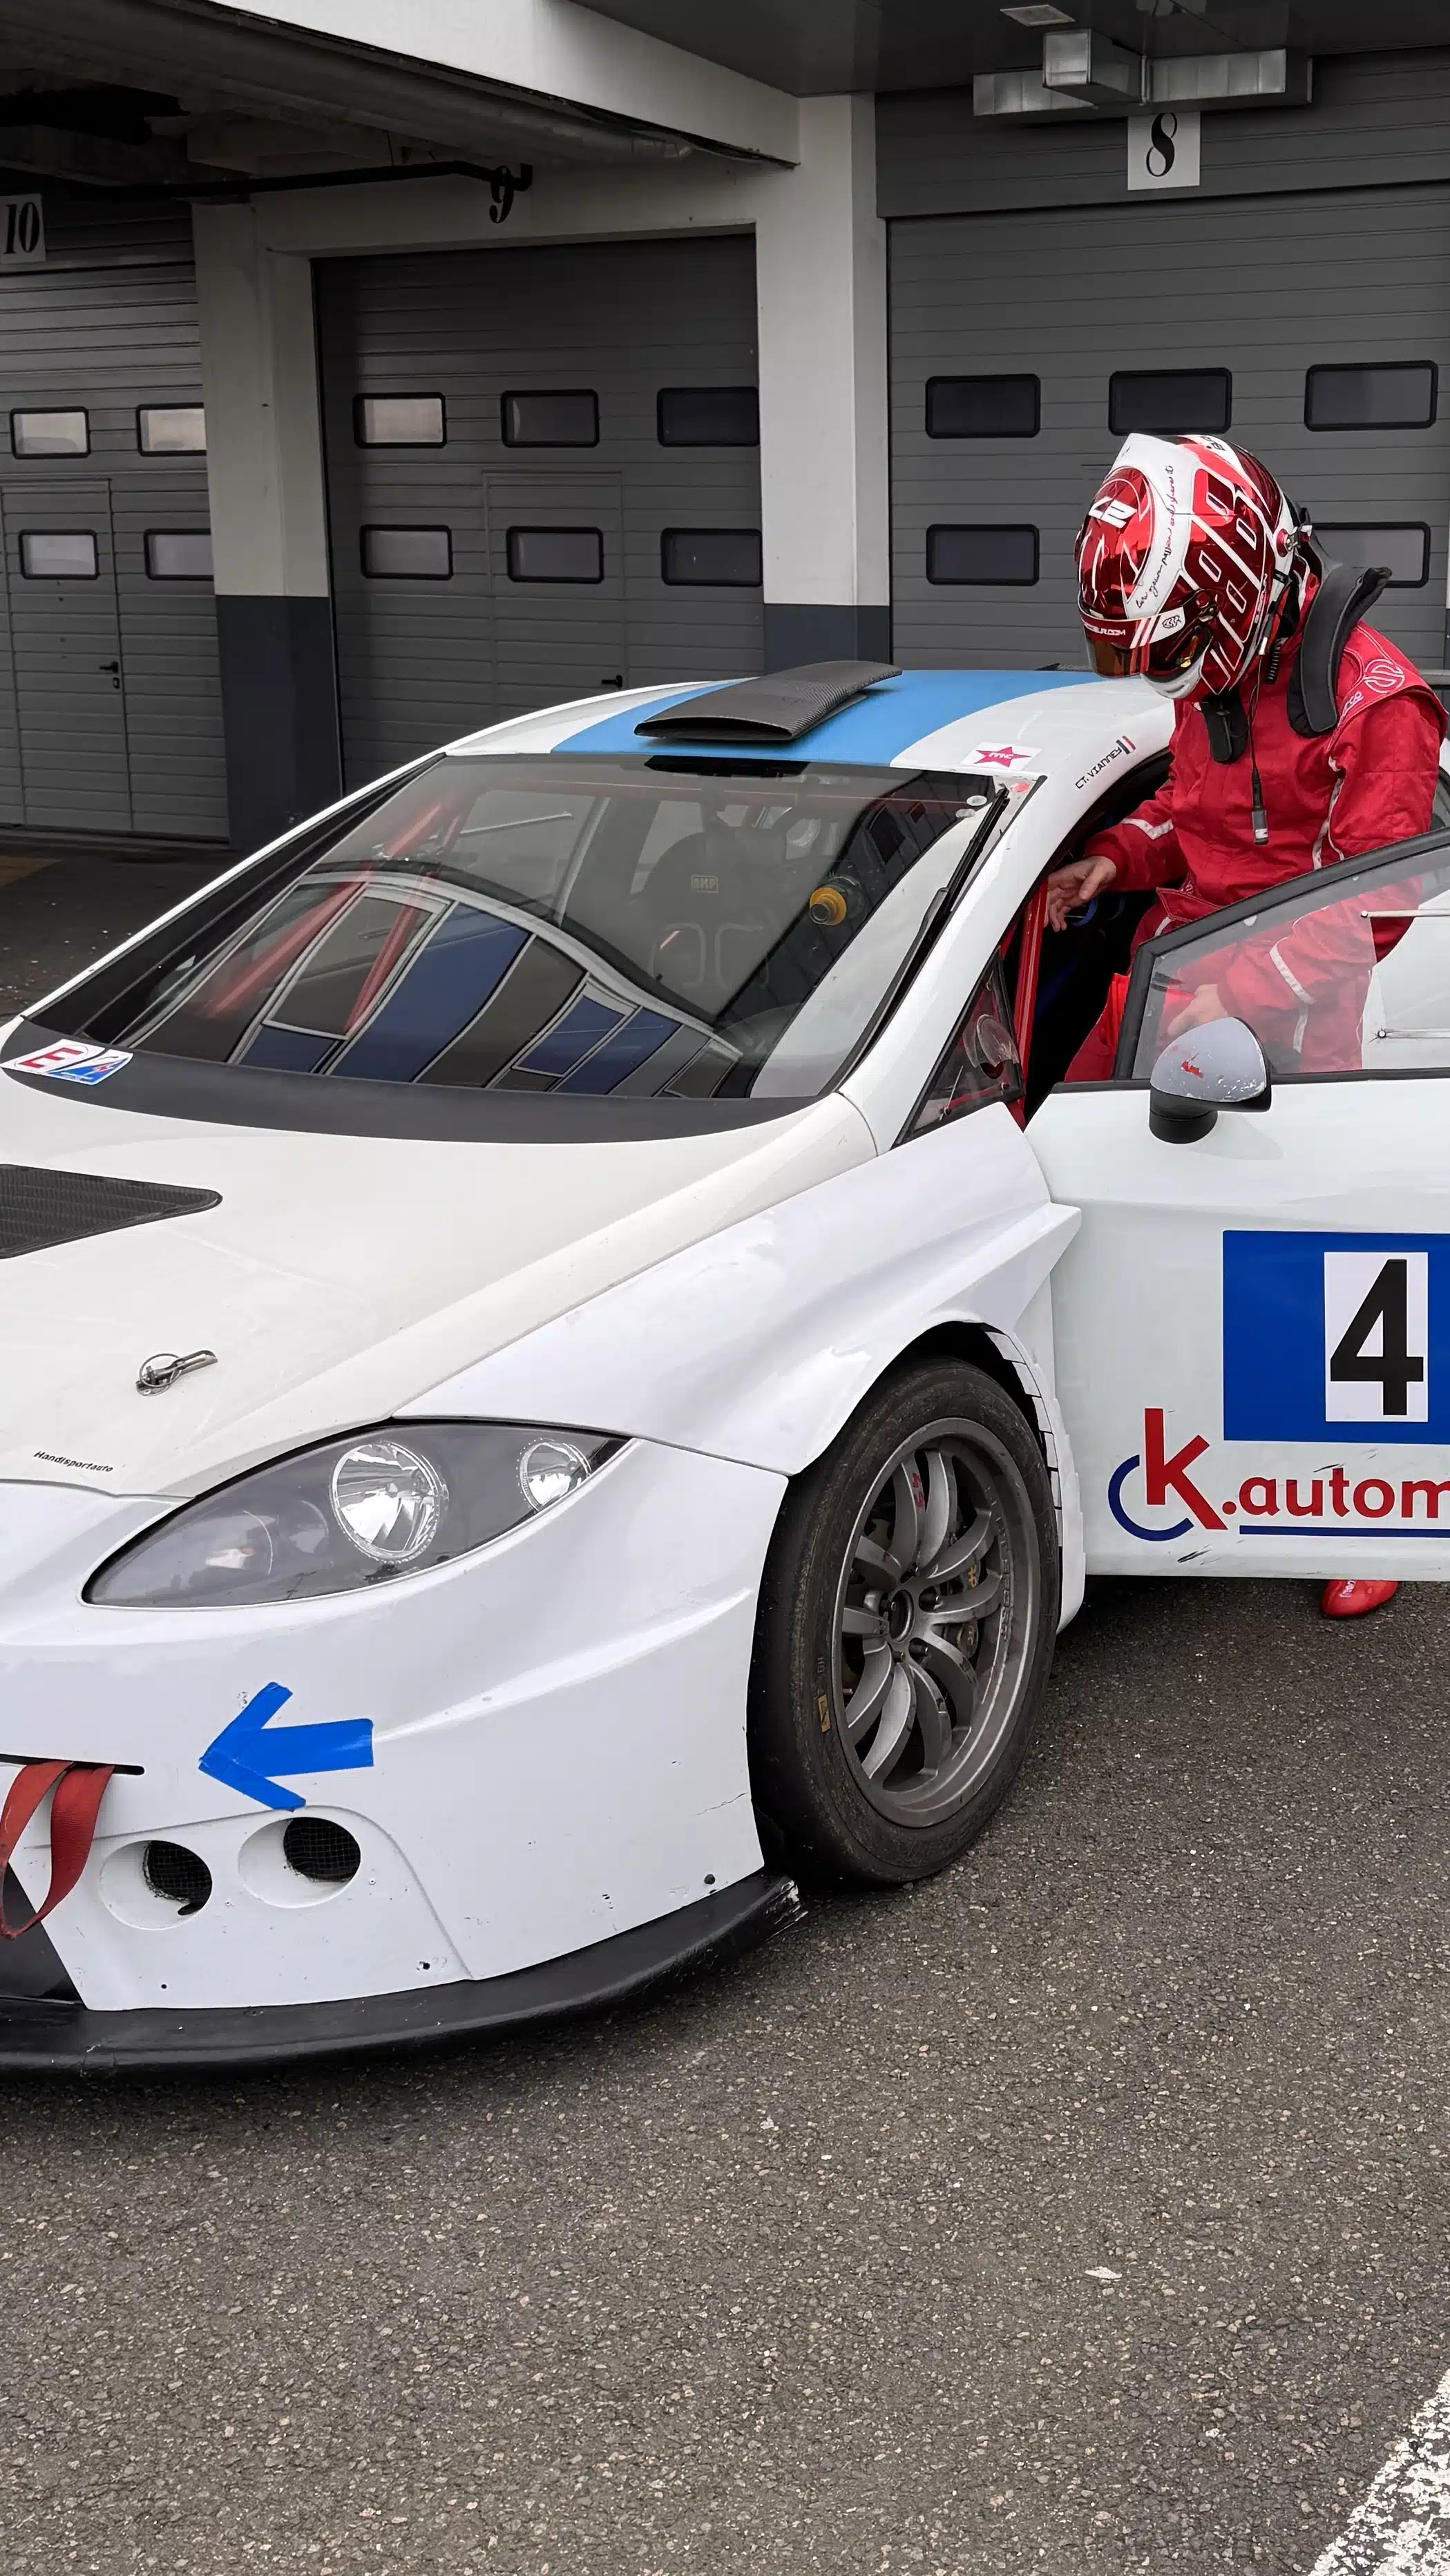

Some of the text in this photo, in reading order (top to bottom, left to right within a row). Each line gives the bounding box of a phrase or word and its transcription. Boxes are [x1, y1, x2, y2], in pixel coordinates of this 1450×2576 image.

[1145, 112, 1179, 177] 8
[488, 164, 515, 224] 9
[3, 201, 41, 255] 10
[1087, 747, 1123, 778] VIANNEY
[17, 1046, 84, 1069] E
[1330, 1258, 1424, 1416] 4
